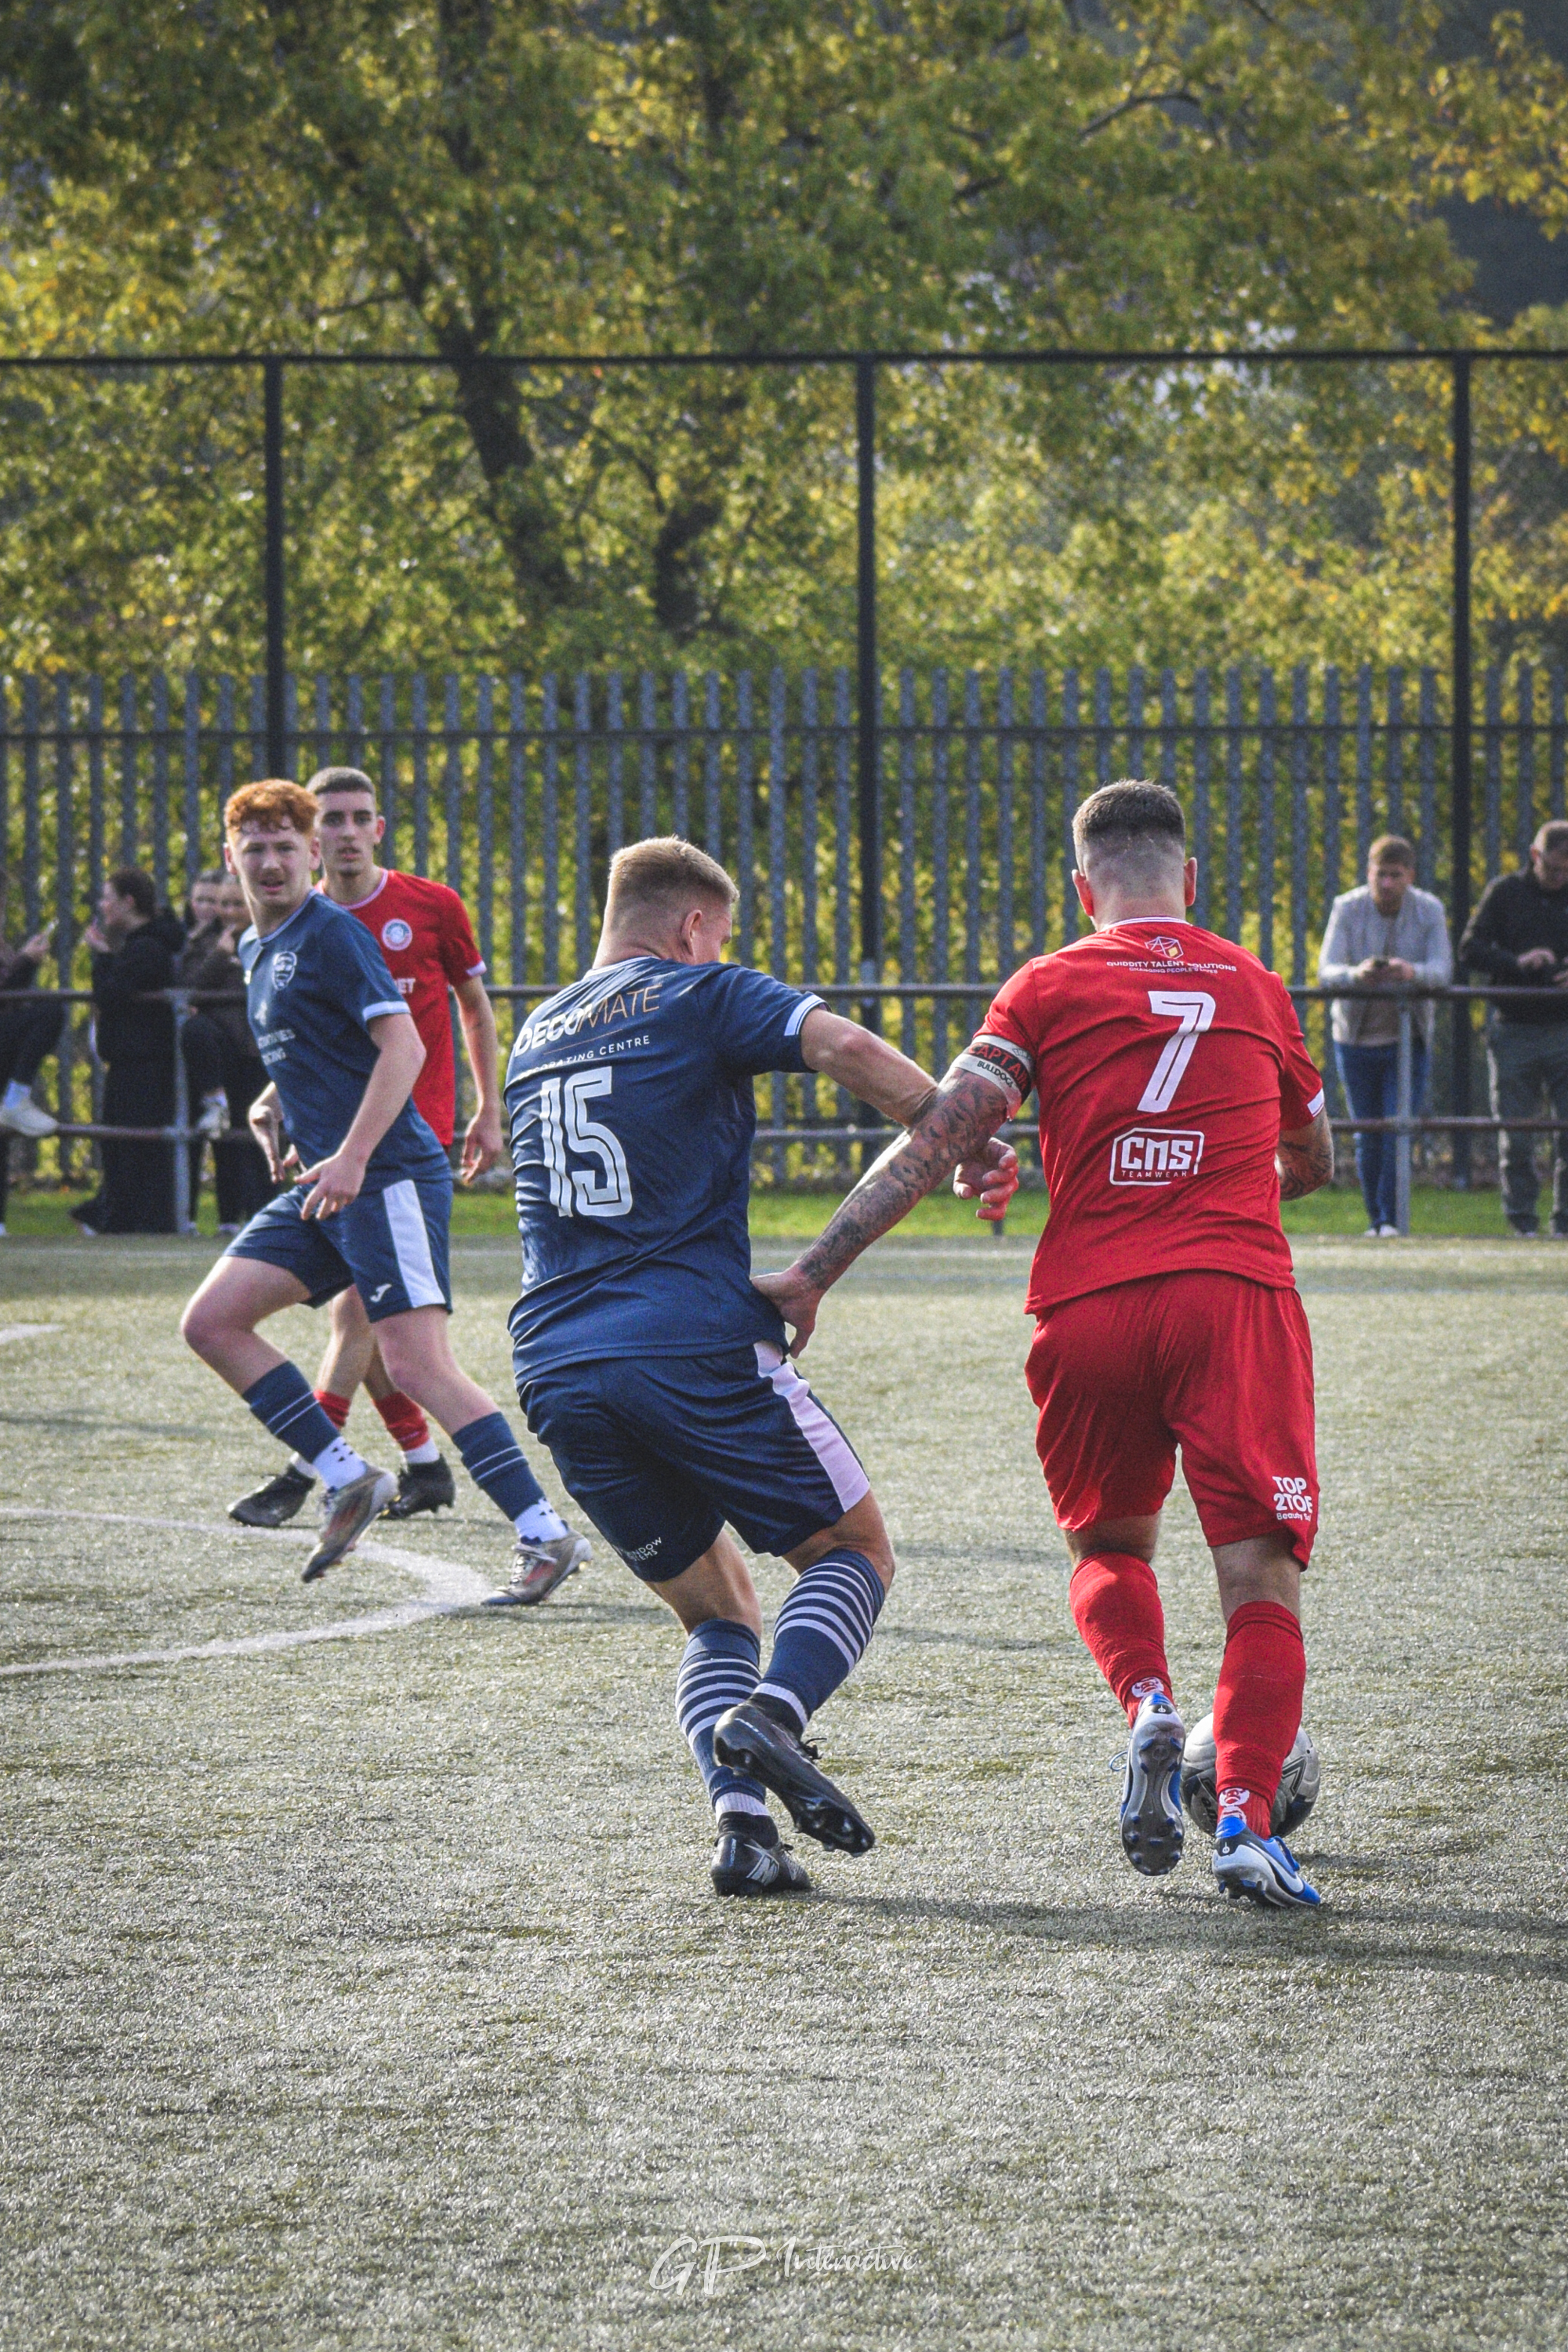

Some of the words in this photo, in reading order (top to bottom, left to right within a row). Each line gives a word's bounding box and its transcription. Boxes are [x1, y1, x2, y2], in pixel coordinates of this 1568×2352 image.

[514, 983, 663, 1058] DECOMATE
[599, 1035, 650, 1056] CENTRE
[1137, 991, 1216, 1112] 7
[540, 1066, 633, 1218] 15
[1120, 1136, 1194, 1171] CMS
[1121, 1170, 1187, 1178] TEAMWEAR
[1272, 1475, 1307, 1495] TOP
